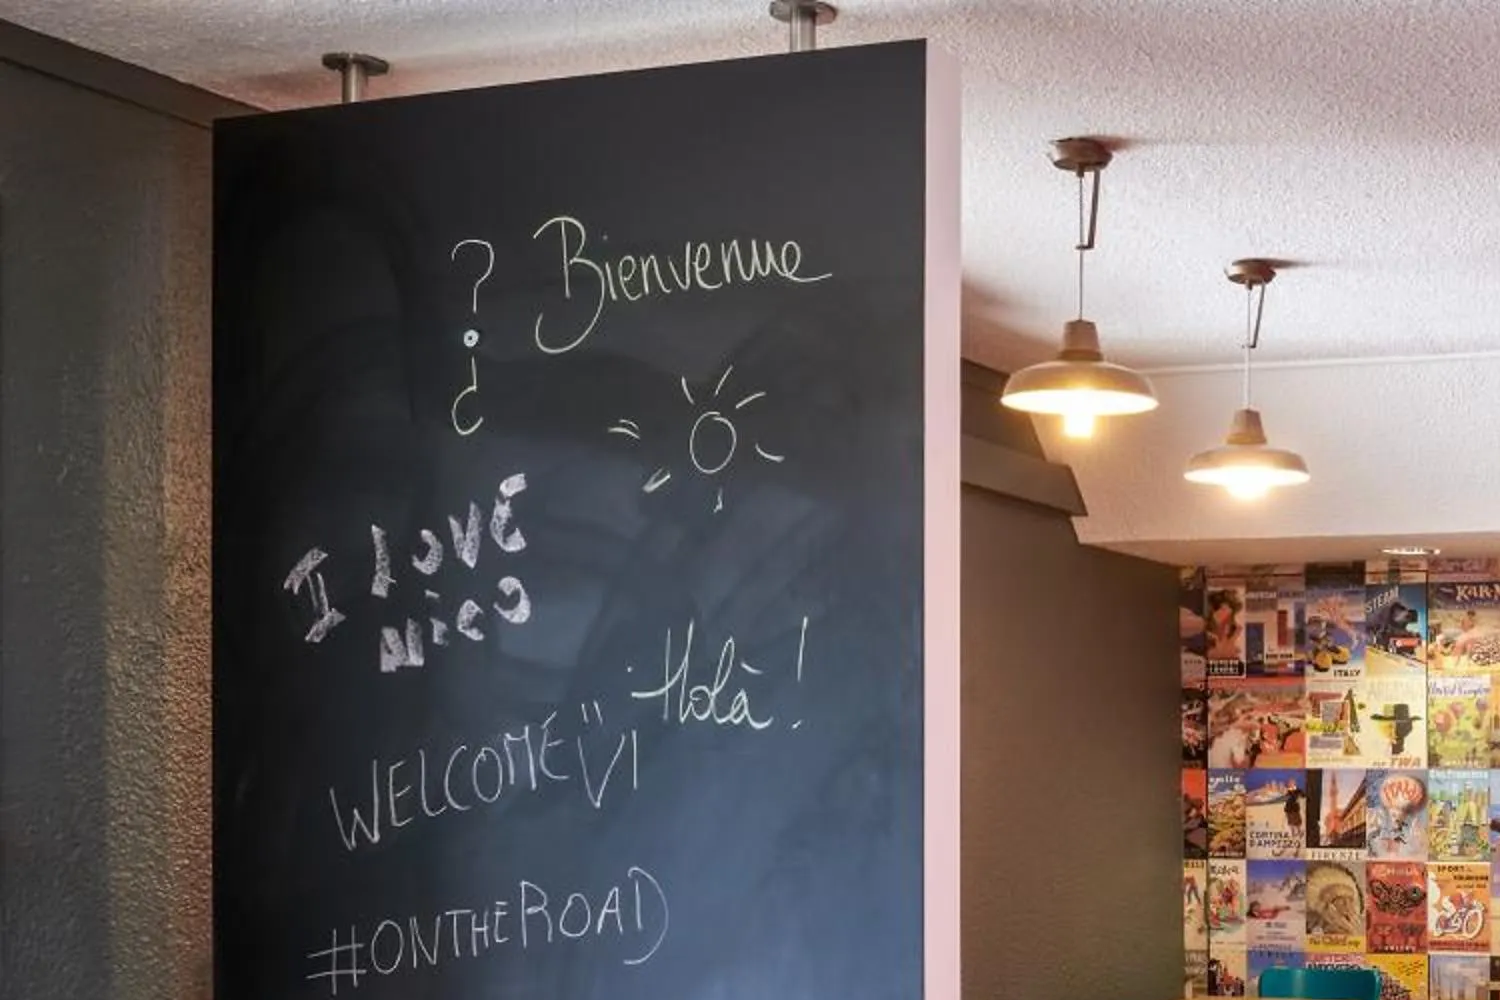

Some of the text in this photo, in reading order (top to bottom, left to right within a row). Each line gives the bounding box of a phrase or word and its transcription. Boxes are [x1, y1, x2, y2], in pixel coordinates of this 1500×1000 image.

[532, 215, 834, 354] Bienvenue
[283, 547, 347, 643] I
[1365, 586, 1400, 613] STEAM
[1333, 669, 1361, 677] ITALY
[1311, 851, 1361, 860] FIRENZE
[305, 865, 670, 996] #ONTHEROAD
